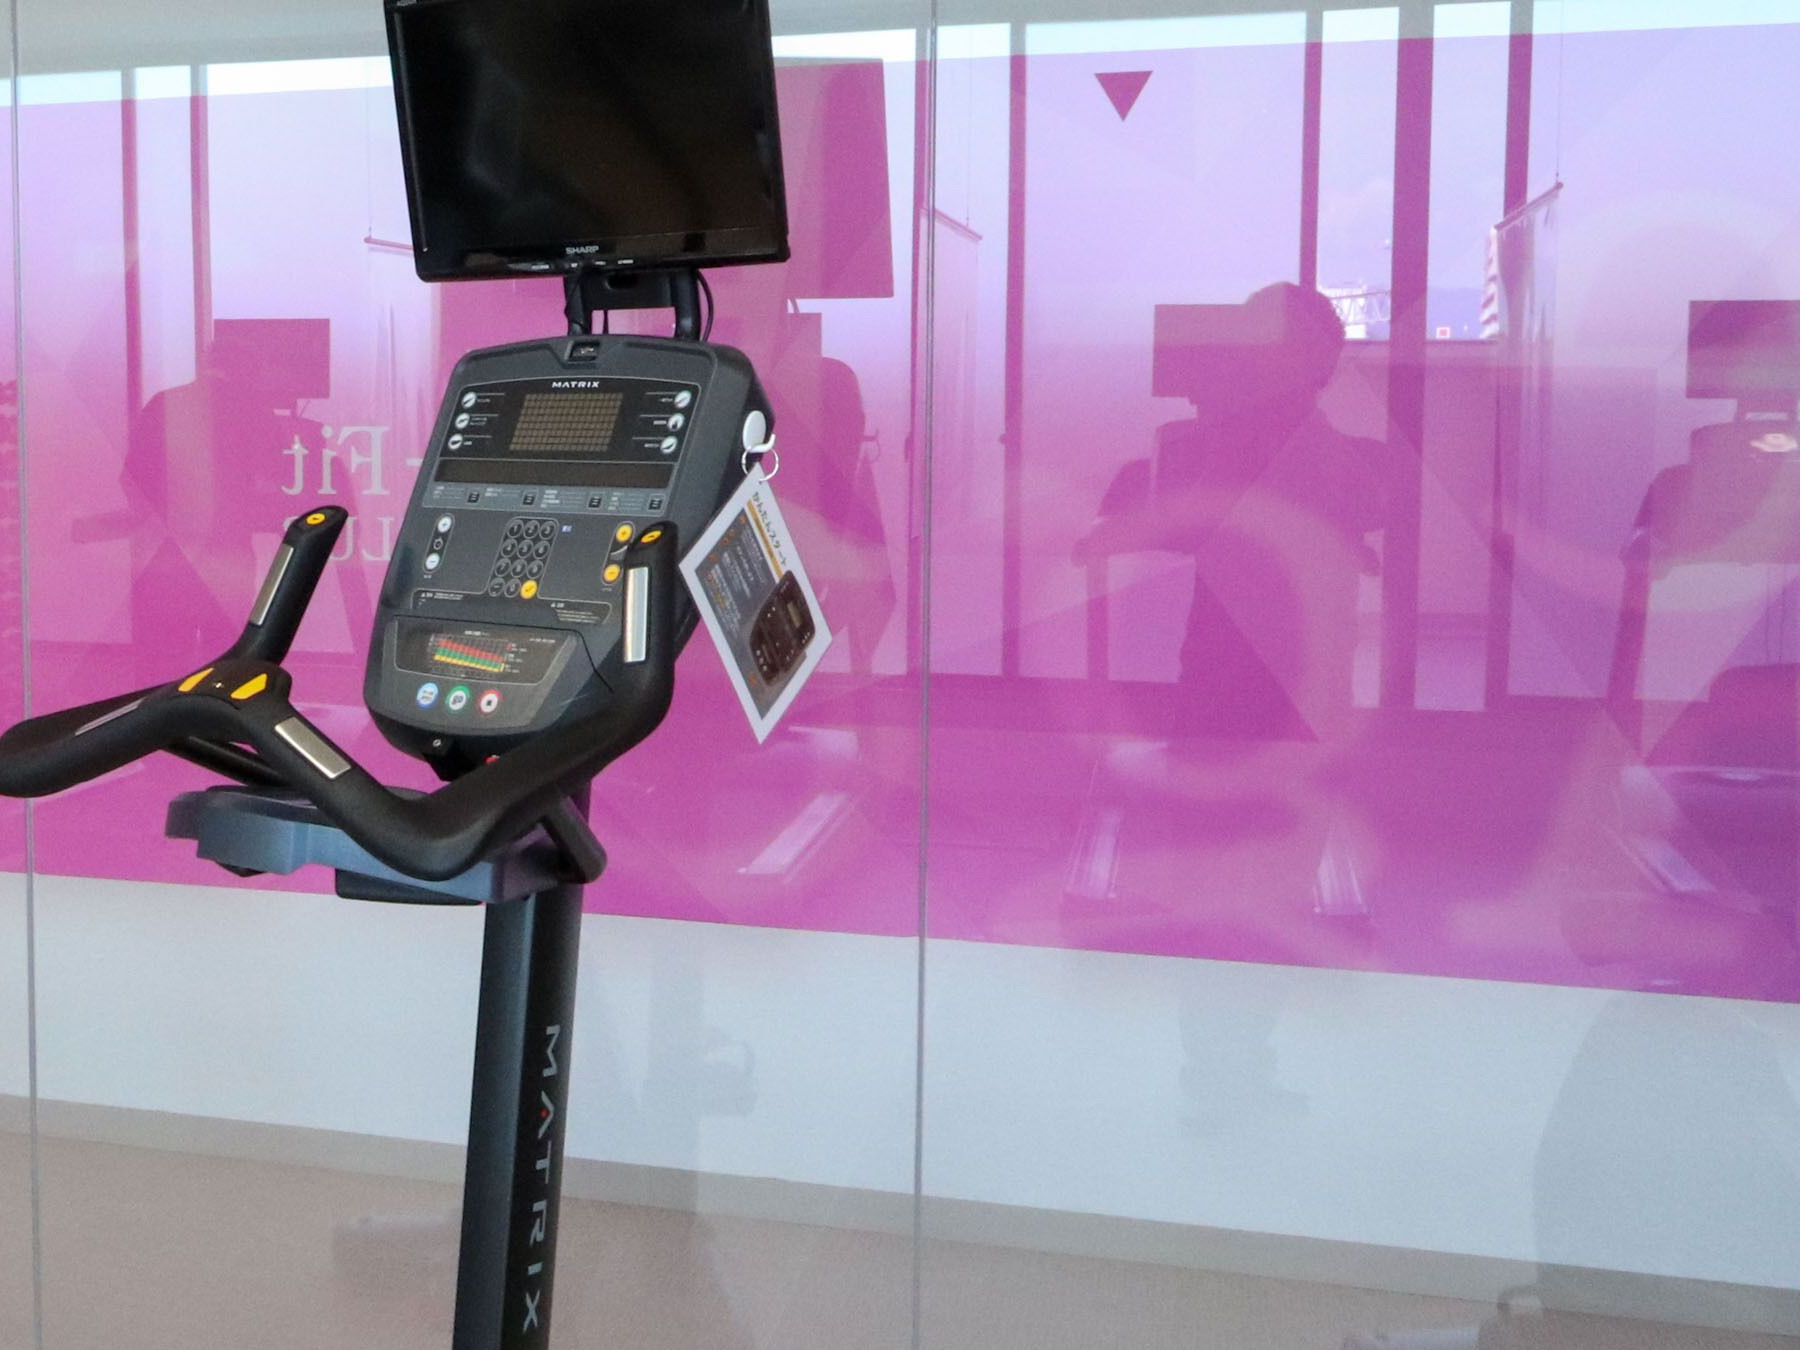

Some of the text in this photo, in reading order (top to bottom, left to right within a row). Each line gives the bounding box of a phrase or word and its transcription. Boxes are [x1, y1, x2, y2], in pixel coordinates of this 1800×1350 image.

[566, 245, 600, 255] SHARP
[551, 380, 601, 389] MATRIX
[523, 1024, 561, 1335] MATRIX
